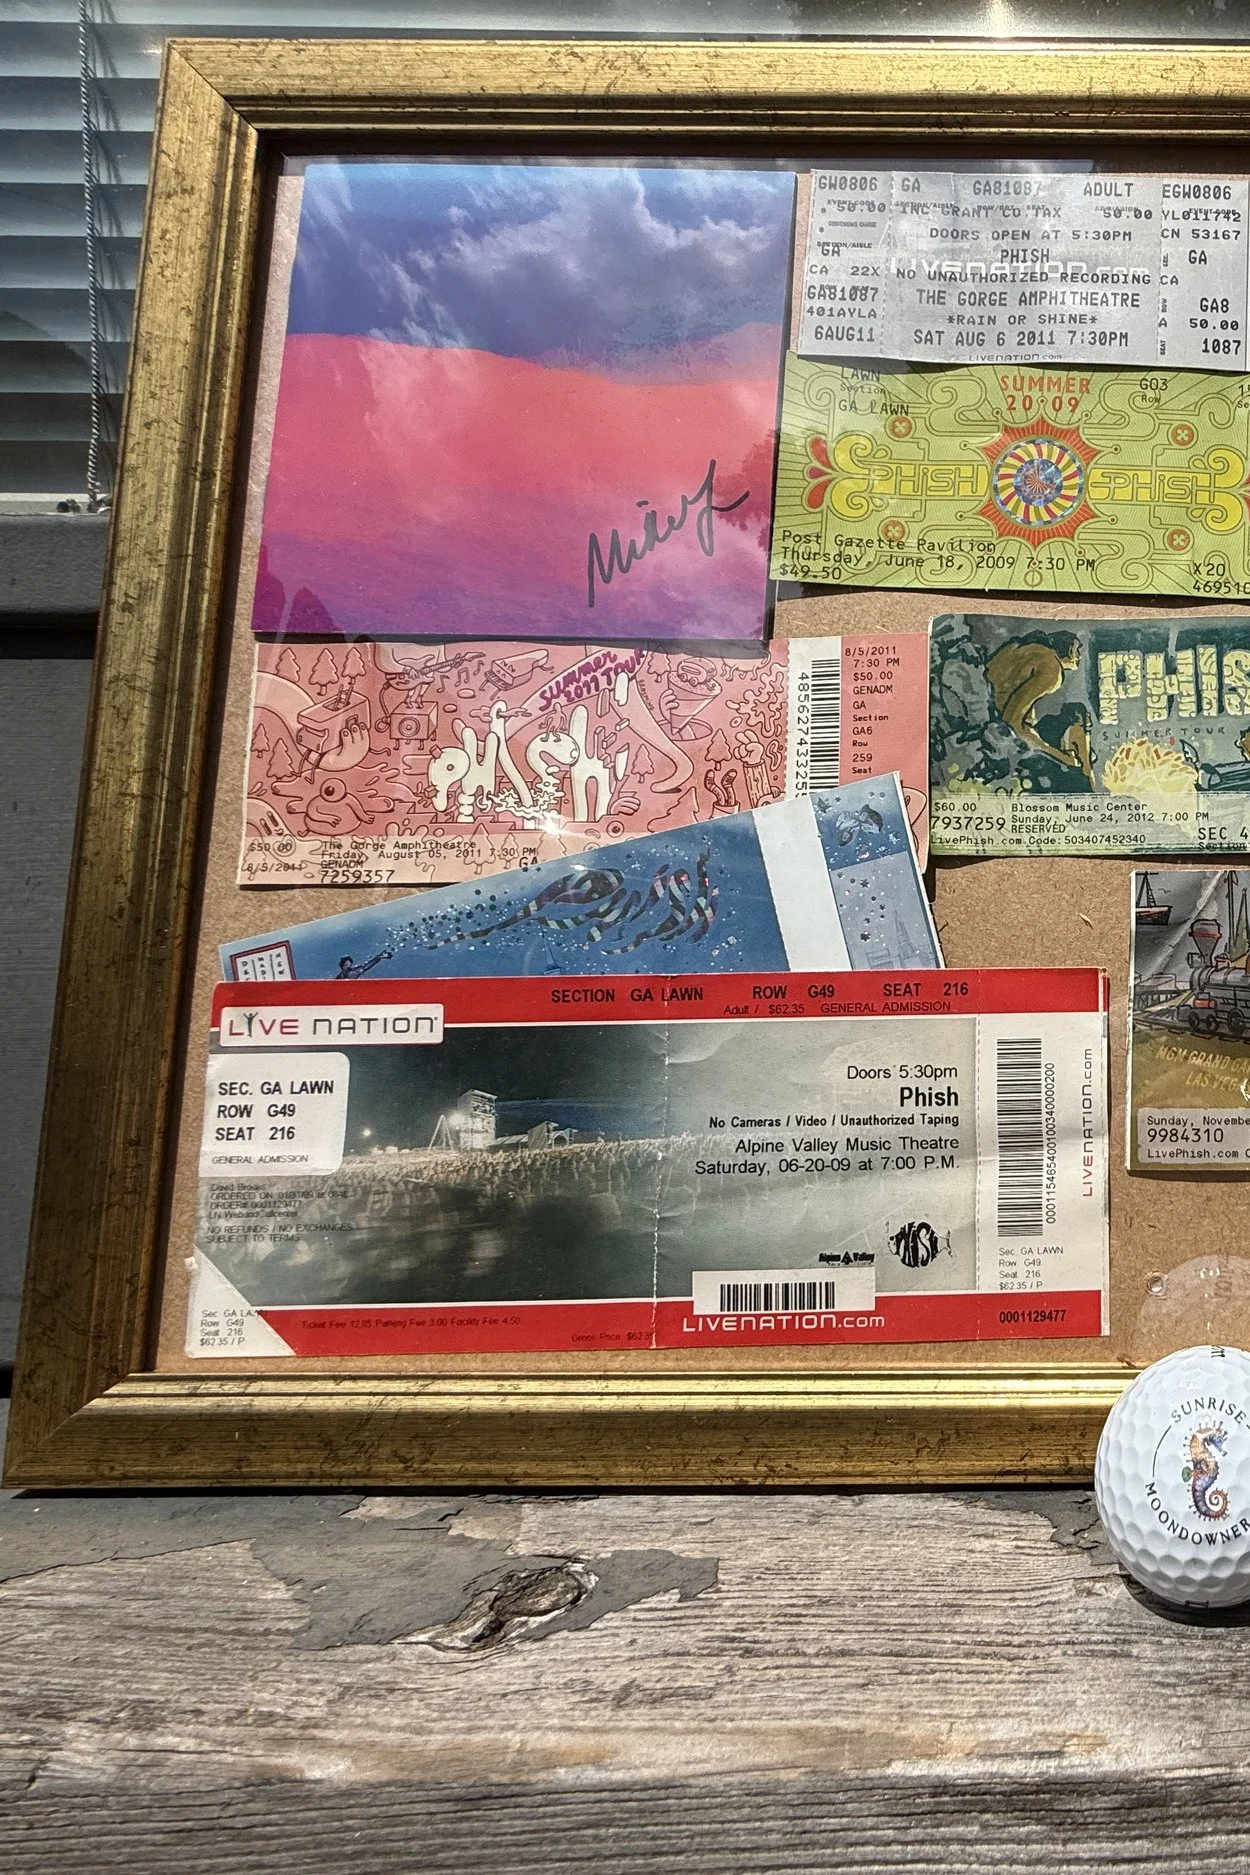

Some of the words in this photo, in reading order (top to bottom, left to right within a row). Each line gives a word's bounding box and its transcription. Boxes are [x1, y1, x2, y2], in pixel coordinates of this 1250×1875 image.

[818, 176, 878, 192] GW0806
[902, 178, 920, 192] GA
[1083, 182, 1134, 197] ADULT
[1162, 184, 1232, 200] EGW0806
[1001, 250, 1050, 263] PHISH
[916, 289, 946, 305] THE
[958, 291, 1008, 306] GORGE
[1019, 291, 1140, 308] AMPHITHEATRE
[914, 330, 945, 346] SAT
[956, 332, 985, 346] AUG
[996, 332, 1005, 345] 6
[1016, 332, 1054, 346] 2011
[1068, 330, 1129, 347] 7:30PM
[1000, 375, 1091, 394] SUMMER
[782, 530, 822, 544] Post
[835, 534, 905, 549] Gazette
[918, 539, 996, 552] Pavilion
[885, 555, 924, 567] June
[938, 556, 963, 570] 18,
[976, 556, 1014, 568] 2009
[1026, 556, 1066, 570] 7:30
[1076, 558, 1095, 571] PM
[845, 646, 896, 656] 8/5/2011
[854, 659, 880, 668] 7:30
[887, 658, 900, 666] PM
[853, 754, 873, 762] 259
[1012, 804, 1059, 812] Blossom
[1066, 803, 1099, 812] Music
[1107, 803, 1147, 811] Center
[932, 817, 1005, 830] 7937259
[1065, 814, 1092, 823] June
[1100, 814, 1119, 824] 24,
[1127, 813, 1154, 822] 2012
[1162, 812, 1188, 821] 7:00
[1199, 827, 1227, 839] SEC
[350, 842, 387, 852] Gorge
[394, 841, 476, 852] Amphitheatre
[321, 870, 395, 883] 7259357
[821, 1002, 877, 1013] GENERAL
[882, 1002, 951, 1012] ADMISSION
[847, 1066, 891, 1080] Doors
[899, 1065, 958, 1081] 5:30pm
[218, 1082, 253, 1096] SEC.
[261, 1082, 282, 1094] GA
[290, 1081, 334, 1094] LAWN
[900, 1087, 959, 1107] Phish
[217, 1105, 254, 1118] ROW
[267, 1104, 296, 1118] G49
[1148, 1116, 1194, 1127] Sunday,
[216, 1127, 255, 1140] SEAT
[269, 1127, 295, 1140] 216
[1148, 1128, 1223, 1143] 9984310
[736, 1138, 784, 1153] Alpine
[792, 1138, 837, 1154] Valley
[846, 1137, 890, 1151] Music
[899, 1136, 959, 1150] Theatre
[695, 1159, 770, 1176] Saturday,
[779, 1158, 851, 1172] 06-20-09
[858, 1157, 873, 1170] at
[881, 1156, 916, 1170] 7:00
[924, 1155, 959, 1169] P.M.
[999, 1310, 1066, 1323] 0001129477
[1171, 1397, 1247, 1424] SUNRISE
